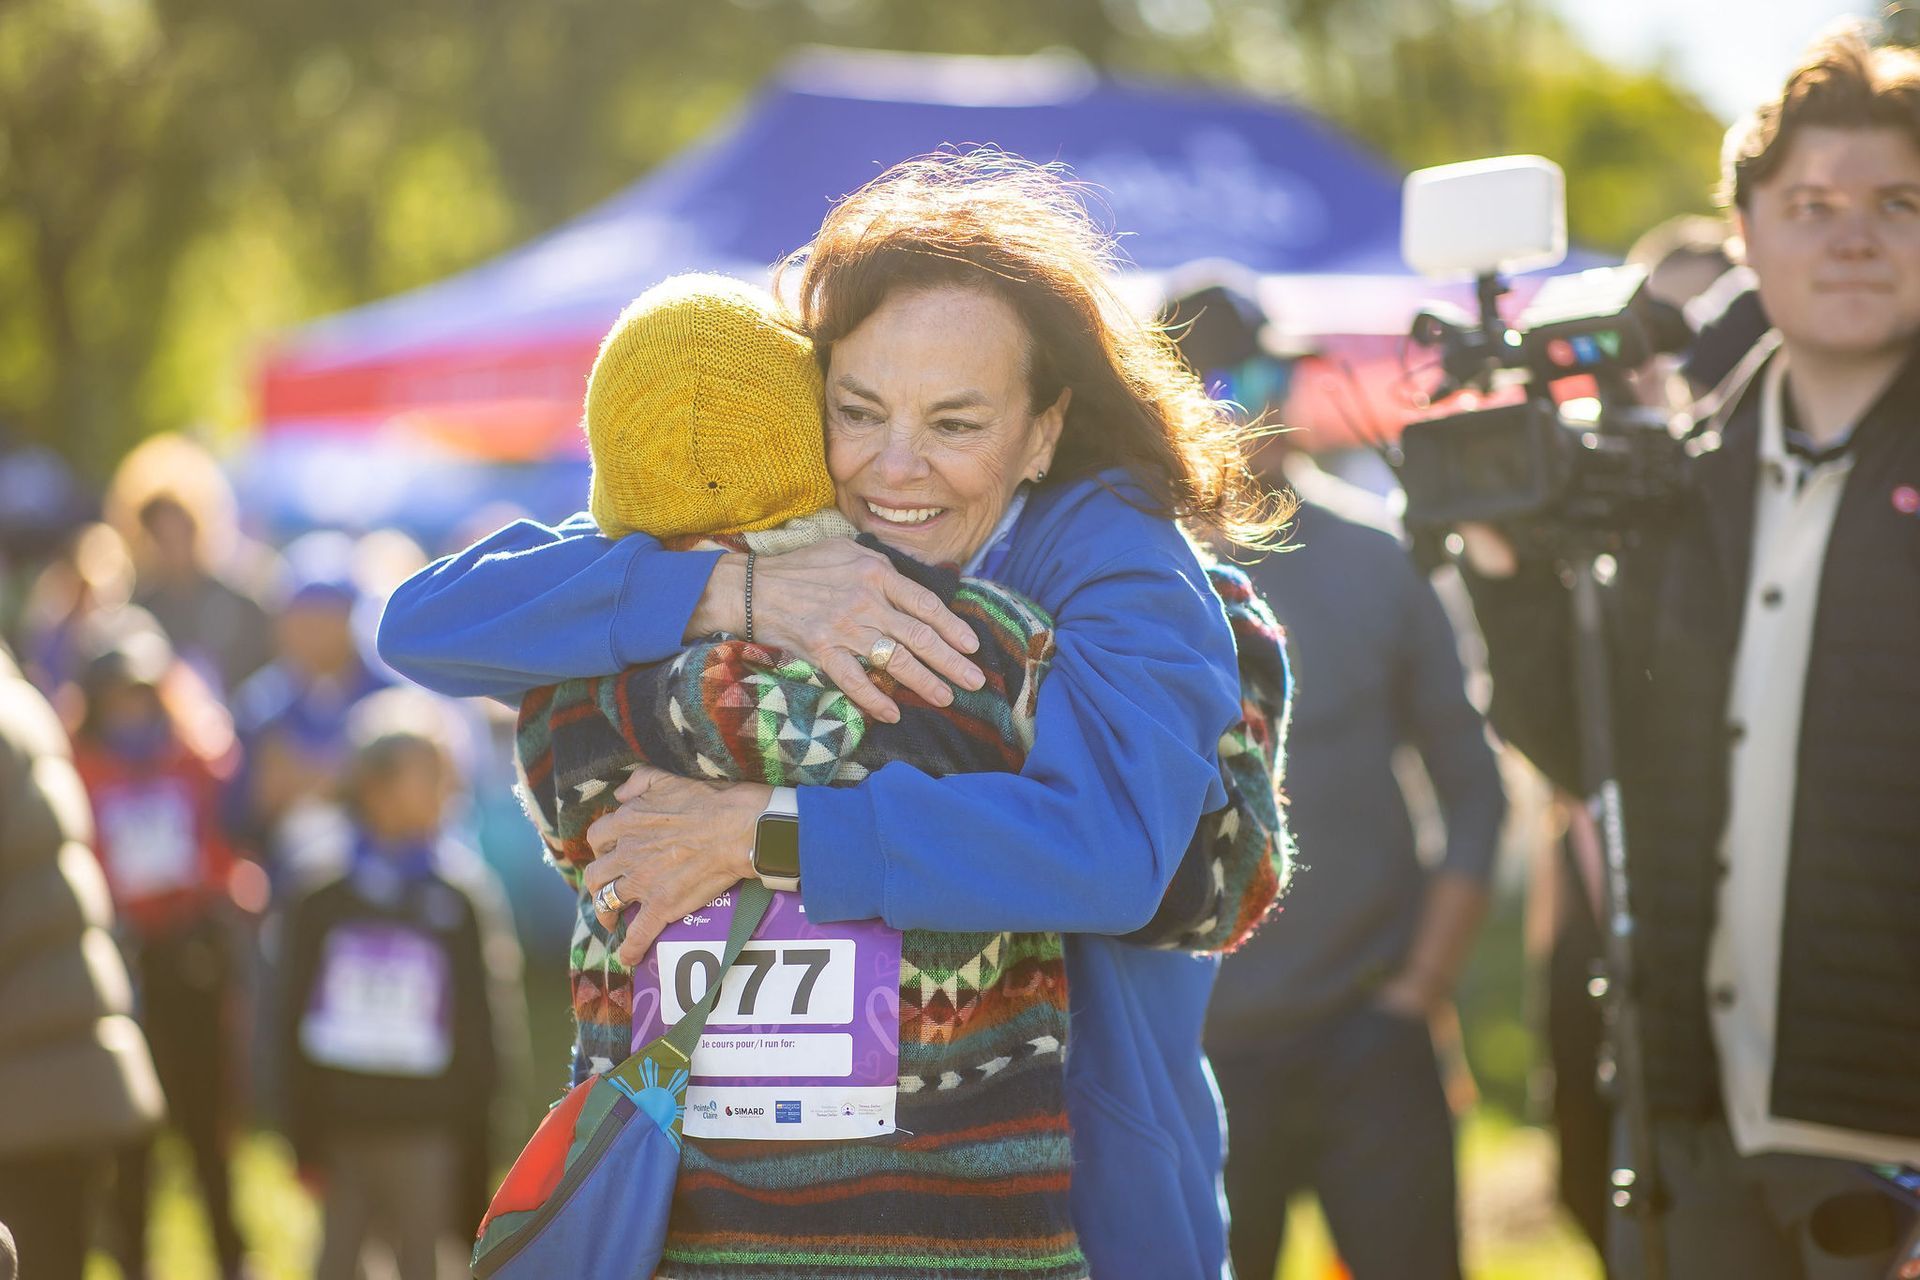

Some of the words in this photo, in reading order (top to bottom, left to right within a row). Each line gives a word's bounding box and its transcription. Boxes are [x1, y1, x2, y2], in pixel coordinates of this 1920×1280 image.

[693, 915, 711, 926] Pfizer
[675, 949, 831, 1015] 077
[702, 1040, 710, 1048] Je
[780, 1039, 796, 1048] for:
[693, 1104, 711, 1112] Pointe
[735, 1107, 764, 1116] SIMARD
